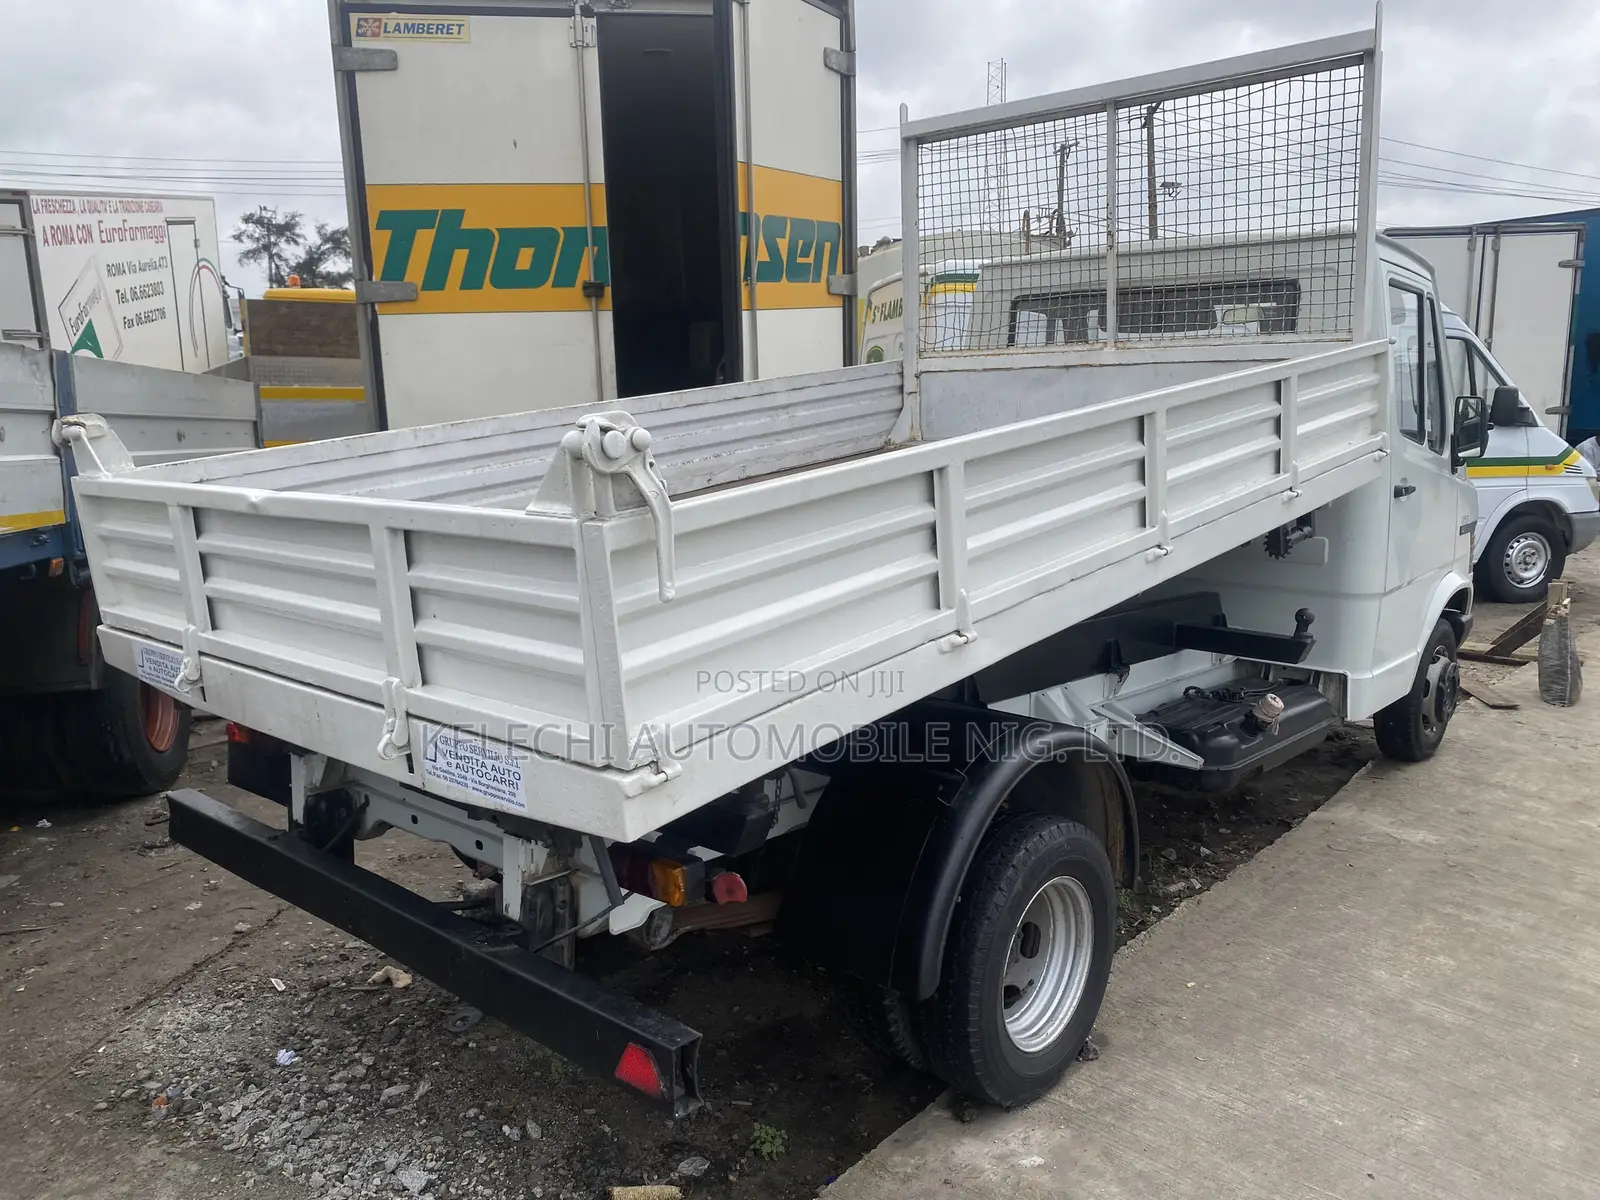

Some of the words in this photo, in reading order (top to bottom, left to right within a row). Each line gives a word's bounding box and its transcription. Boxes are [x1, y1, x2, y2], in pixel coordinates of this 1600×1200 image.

[383, 22, 464, 35] LAMBERET
[42, 224, 50, 247] A
[50, 223, 76, 247] ROMA
[76, 223, 94, 244] CON
[106, 262, 126, 278] ROMA
[126, 260, 137, 275] Via
[115, 287, 129, 305] Tel.
[122, 315, 135, 330] Fax
[170, 664, 182, 673] AUT
[439, 734, 468, 753] GRUPPO
[441, 748, 488, 770] VENDITA
[491, 763, 521, 781] AUTO
[446, 760, 453, 768] e
[455, 761, 519, 791] AUTOCARRI
